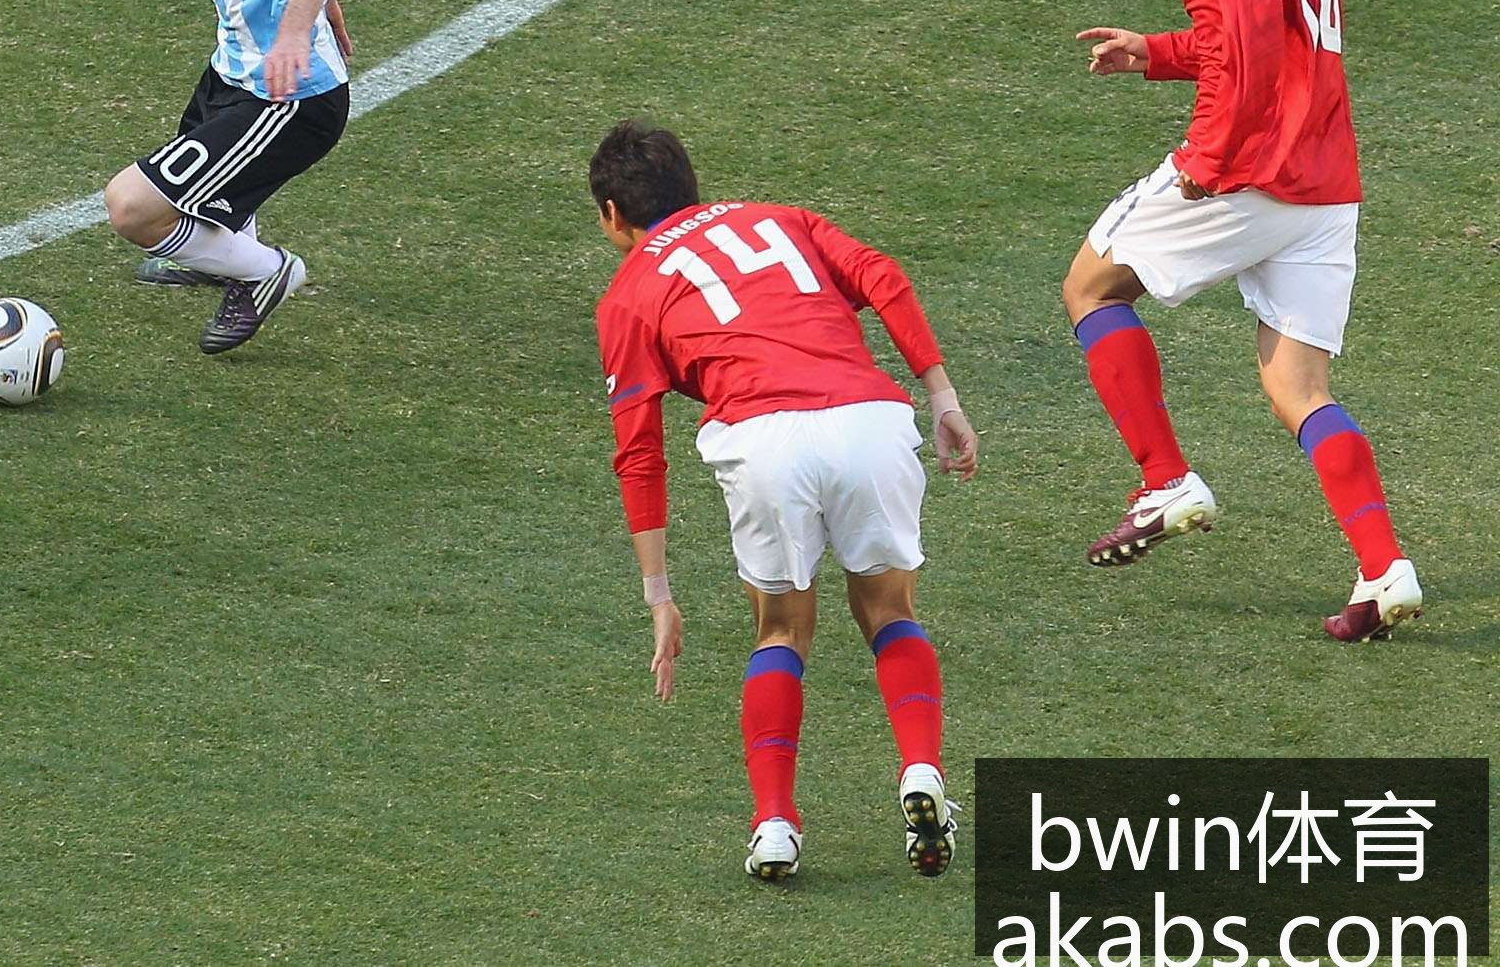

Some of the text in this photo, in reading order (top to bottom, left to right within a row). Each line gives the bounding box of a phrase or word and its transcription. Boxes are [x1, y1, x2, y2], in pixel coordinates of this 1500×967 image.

[148, 134, 209, 185] 10
[643, 202, 745, 258] JUNGSOO
[657, 218, 821, 326] 14
